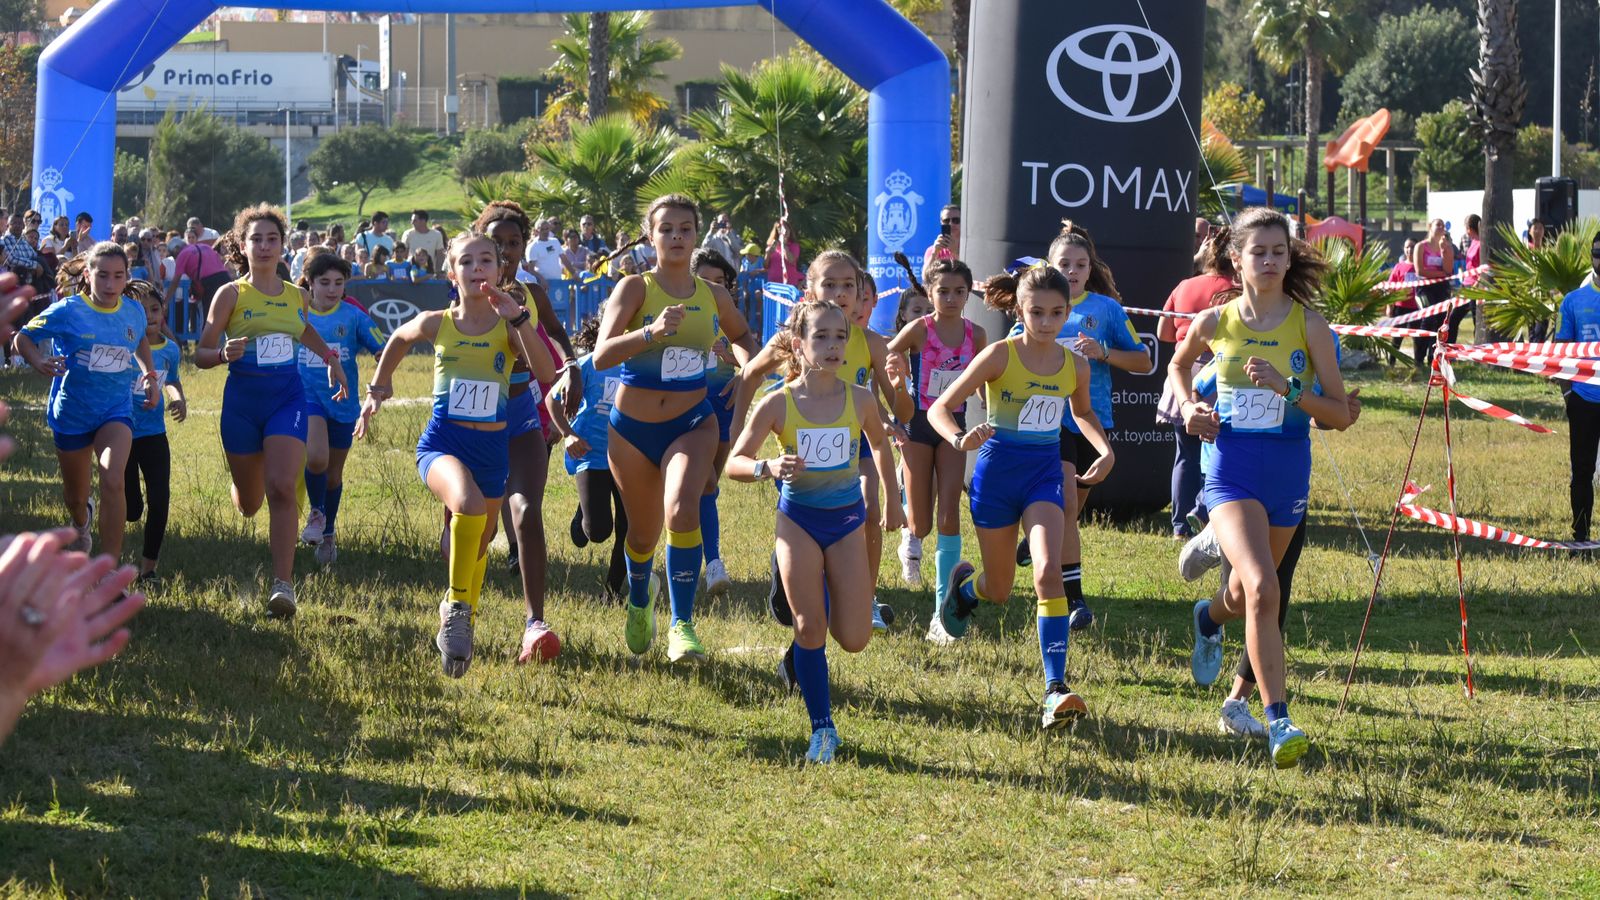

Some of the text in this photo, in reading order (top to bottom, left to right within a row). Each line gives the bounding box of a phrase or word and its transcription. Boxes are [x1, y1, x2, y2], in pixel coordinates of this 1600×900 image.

[163, 69, 273, 86] PrimaFrio
[1021, 161, 1193, 213] TOMAX
[91, 345, 126, 369] 254
[260, 335, 293, 359] 255
[666, 349, 704, 373] 353
[454, 382, 490, 410] 211
[1235, 393, 1281, 422] 354
[1020, 399, 1057, 425] 210
[801, 432, 845, 464] 269
